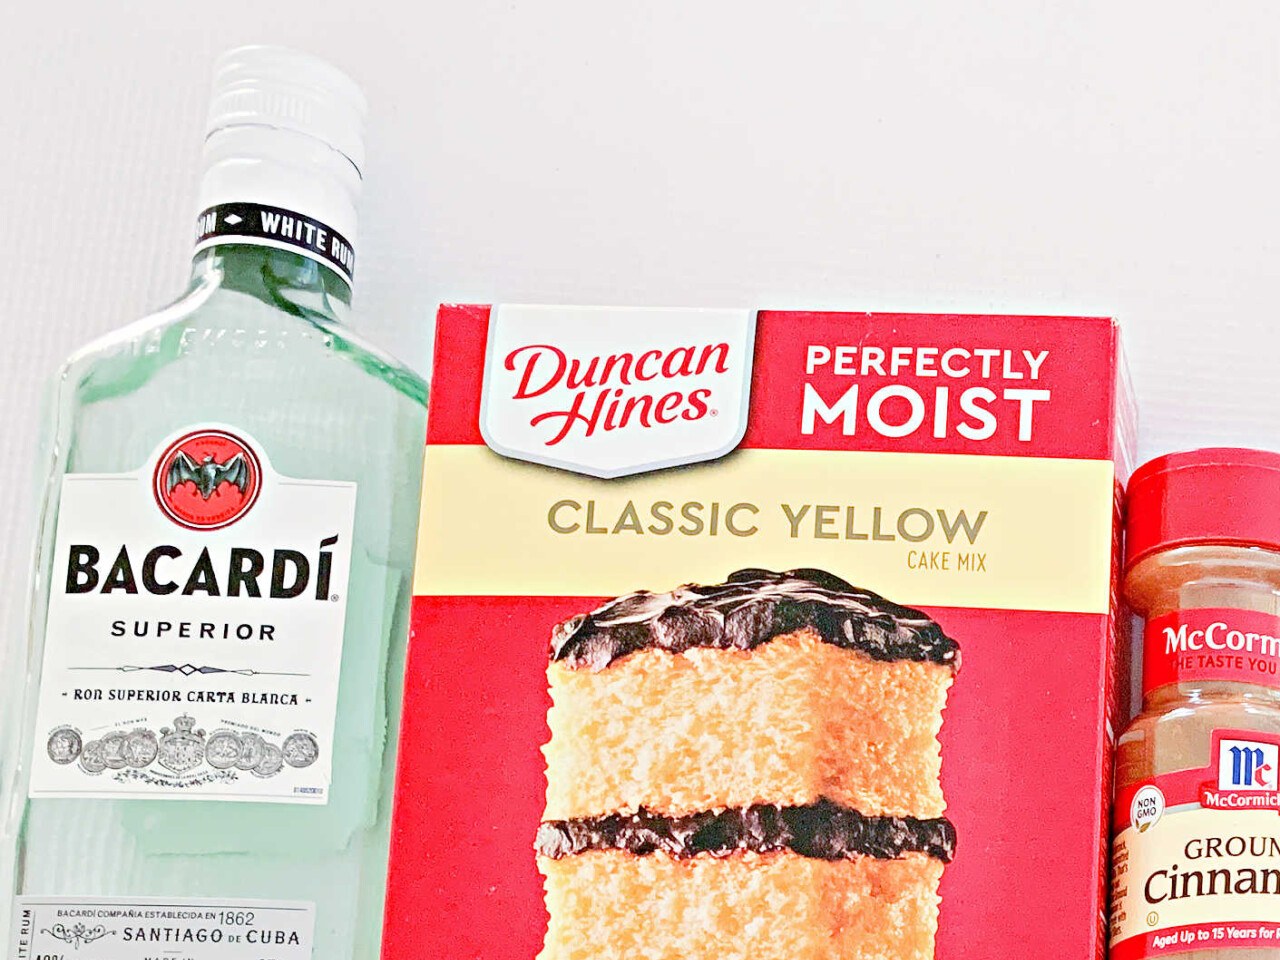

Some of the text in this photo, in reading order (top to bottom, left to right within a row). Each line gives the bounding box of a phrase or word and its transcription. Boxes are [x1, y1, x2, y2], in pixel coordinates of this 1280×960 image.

[260, 210, 328, 251] WHITE
[503, 341, 732, 399] Duncan
[804, 345, 1050, 382] PERFECTLY
[529, 386, 712, 447] Hines
[800, 382, 1052, 443] MOIST
[546, 498, 989, 545] CLASSIC YELLOW
[64, 534, 339, 602] BACARDÍ
[906, 549, 987, 573] CAKE MIX
[110, 619, 277, 642] SUPERIOR
[1199, 654, 1244, 670] TASTE
[1249, 657, 1277, 675] YOU
[73, 687, 300, 706] RON SUPERIOR CARTA BLANCA
[1136, 807, 1157, 819] GMO
[1137, 796, 1156, 809] NON
[20, 909, 32, 936] RUM
[122, 926, 301, 946] SANTIAGO DE CUBA
